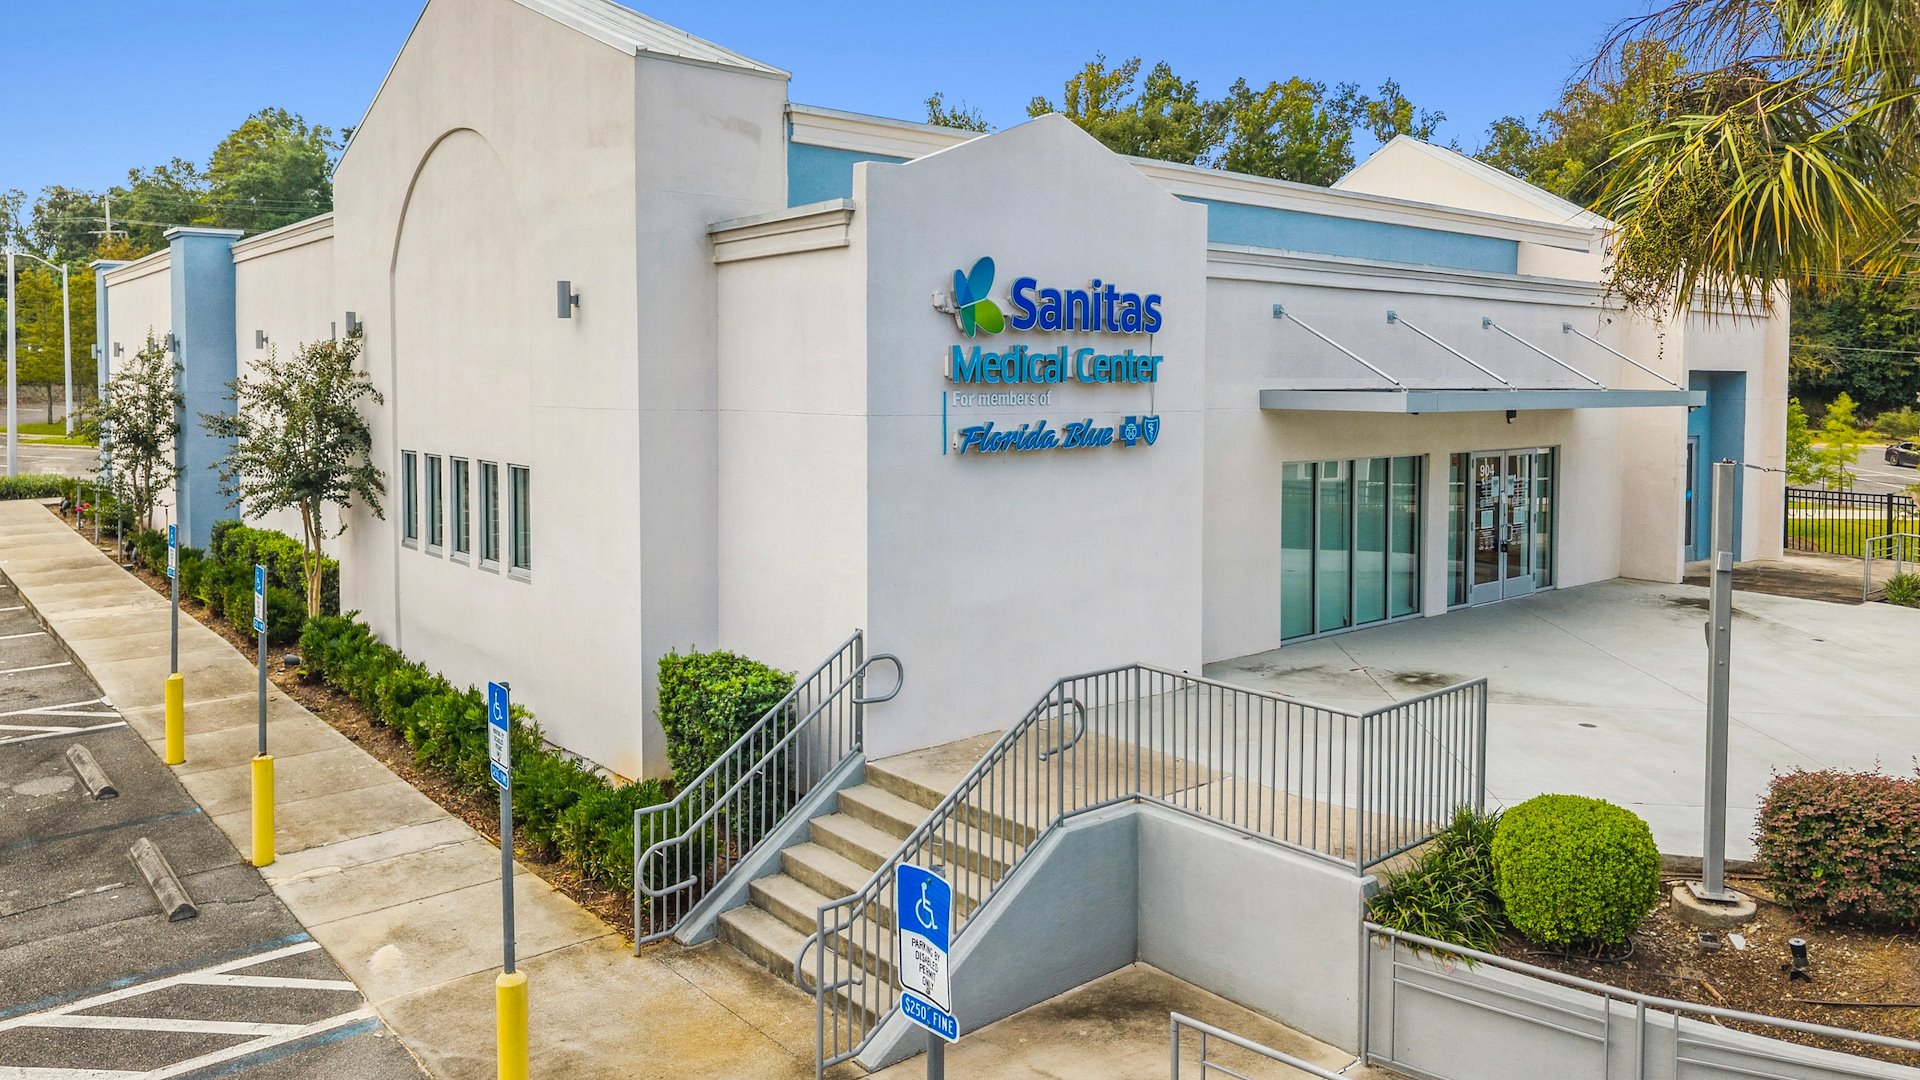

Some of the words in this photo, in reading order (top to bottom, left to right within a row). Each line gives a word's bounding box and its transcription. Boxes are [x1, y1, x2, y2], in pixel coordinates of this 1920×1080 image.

[1011, 276, 1162, 334] Sanitas
[952, 345, 1068, 384] Medical
[1076, 347, 1164, 384] Center
[952, 390, 975, 407] For
[977, 391, 1036, 407] members
[1039, 390, 1052, 406] of
[959, 419, 1060, 455] Florida
[1062, 418, 1114, 448] Blue
[1480, 463, 1495, 477] 904
[911, 938, 933, 957] PARKING
[934, 951, 940, 962] BY
[915, 950, 939, 973] DISABLED
[919, 963, 936, 982] PERMIT
[922, 976, 934, 991] ONLY
[933, 1012, 954, 1035] FINE
